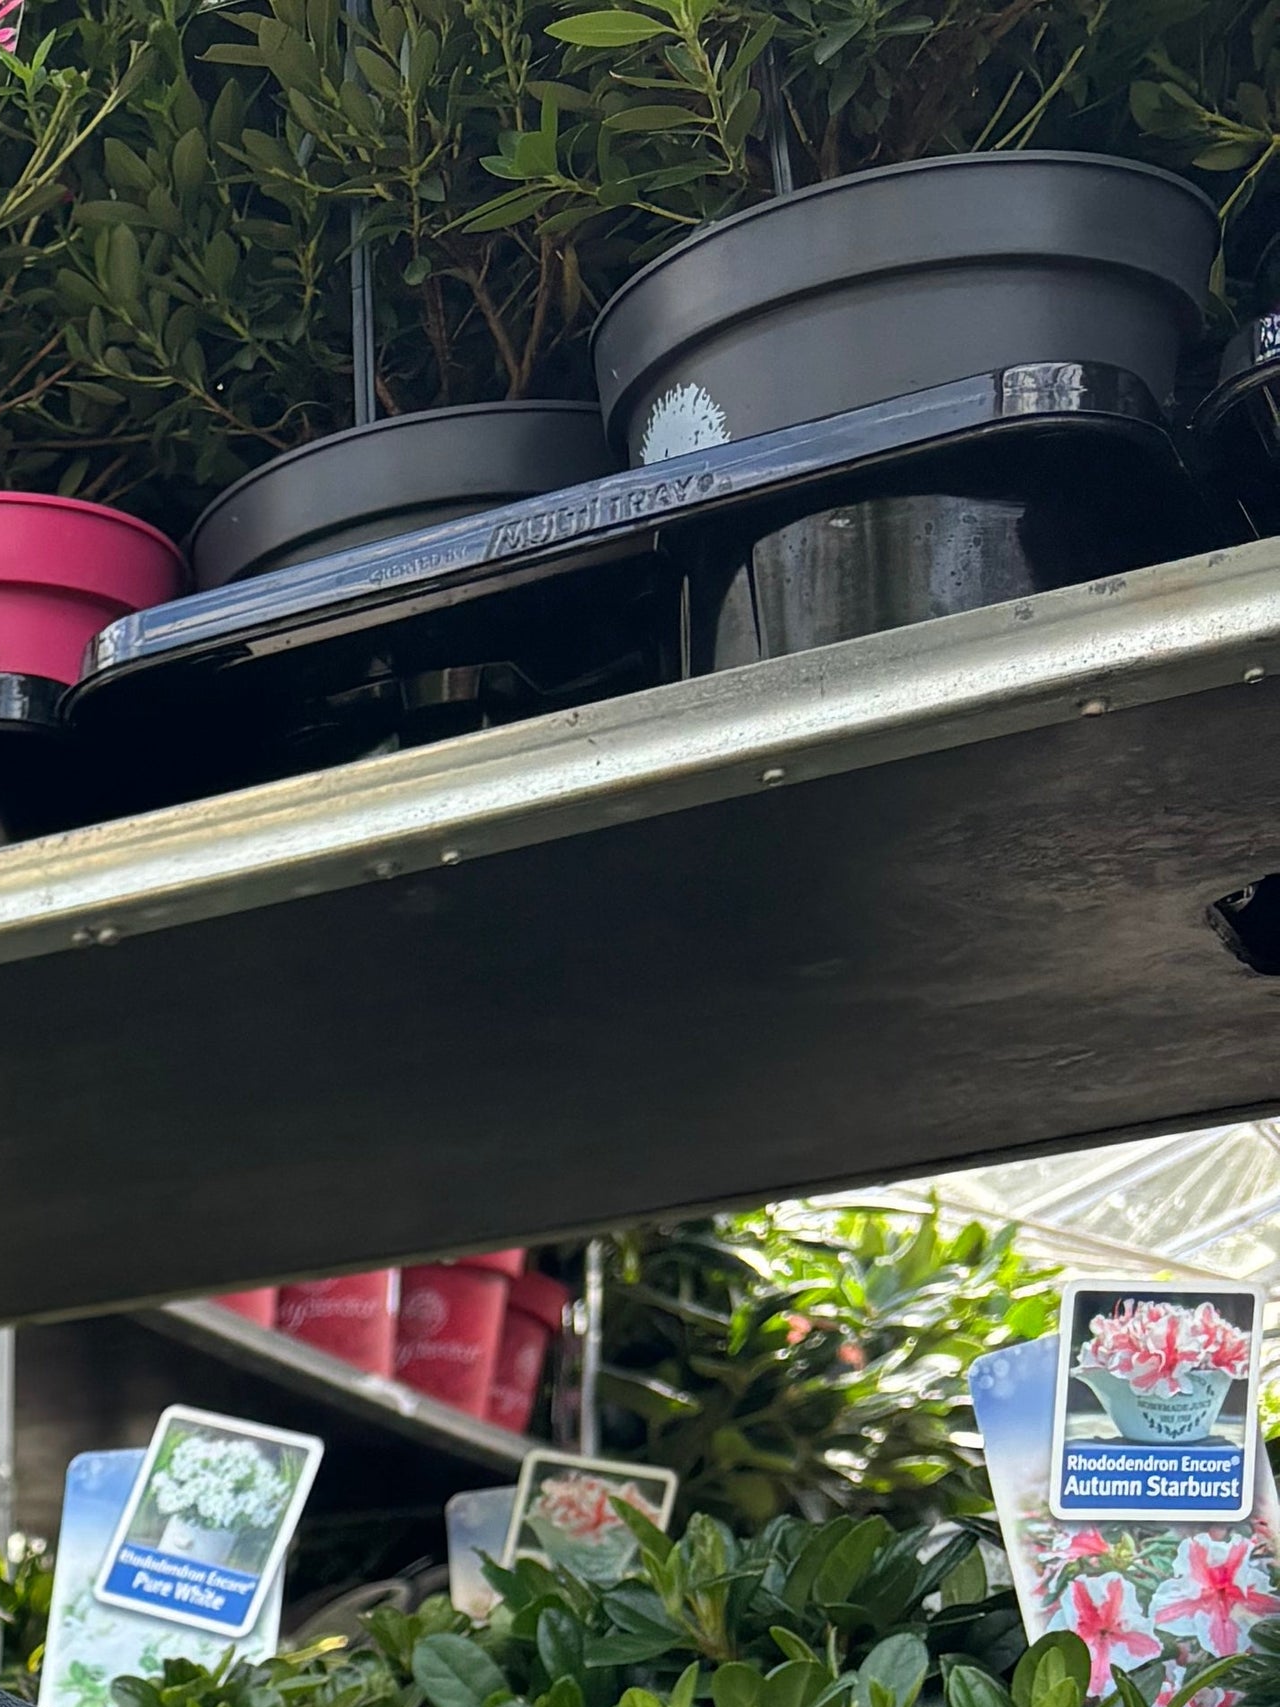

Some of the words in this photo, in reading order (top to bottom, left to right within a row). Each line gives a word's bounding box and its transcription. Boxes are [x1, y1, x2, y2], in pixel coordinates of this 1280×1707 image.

[1066, 1455, 1178, 1472] Rhododendron
[1064, 1475, 1142, 1497] Autumn
[1146, 1476, 1240, 1498] Starburst
